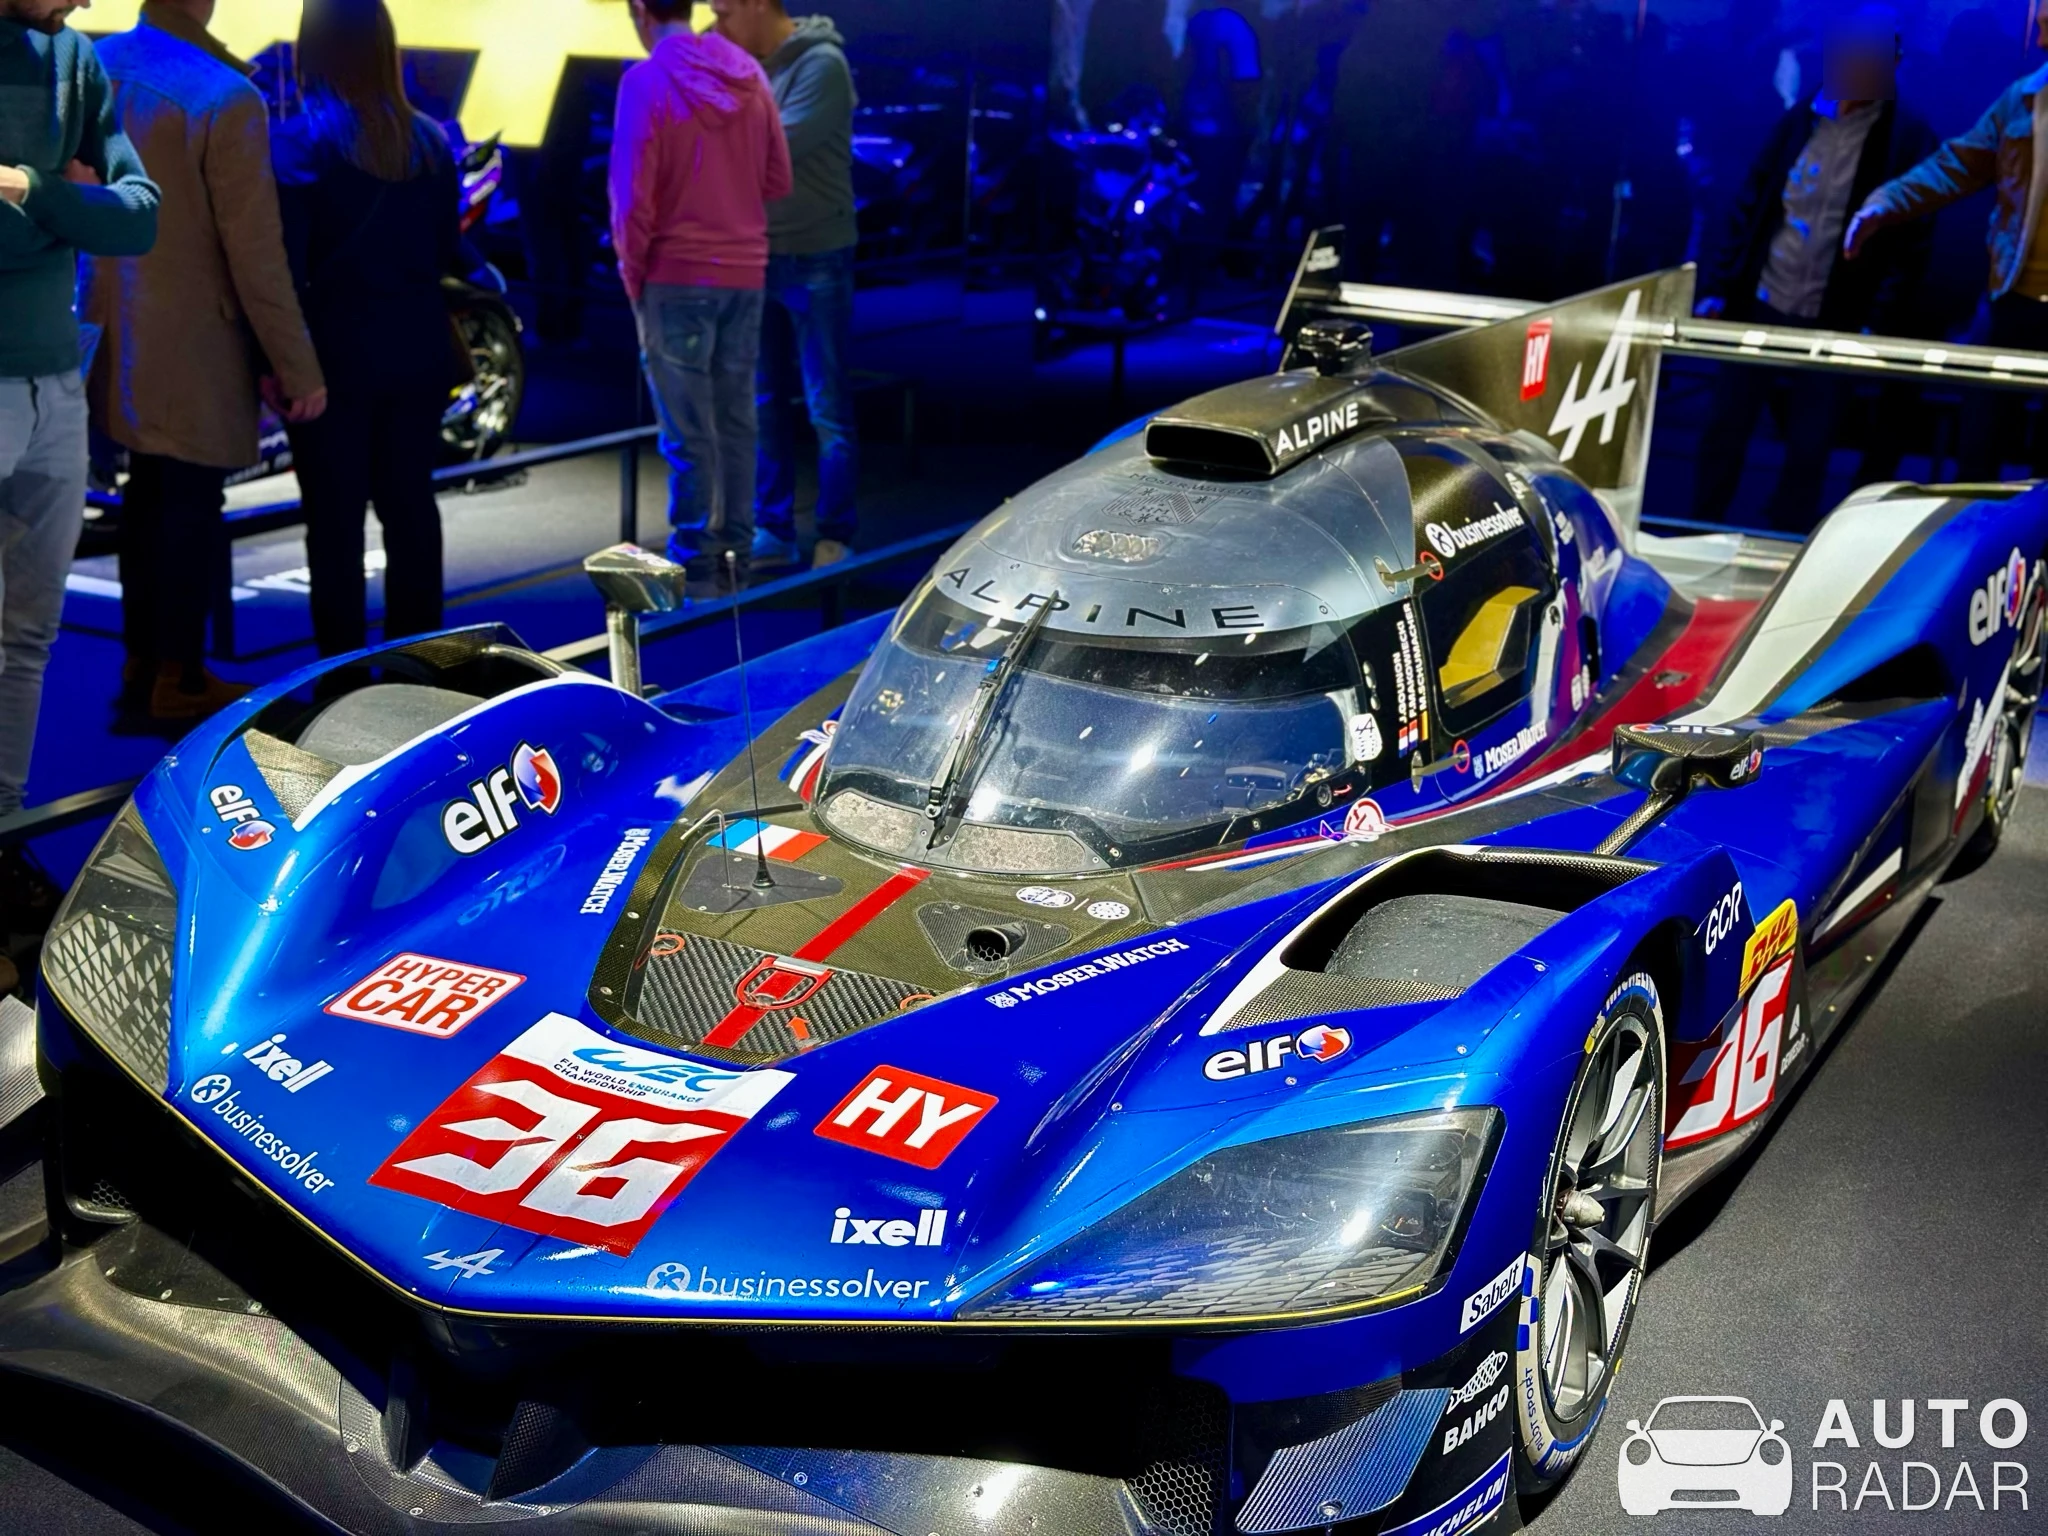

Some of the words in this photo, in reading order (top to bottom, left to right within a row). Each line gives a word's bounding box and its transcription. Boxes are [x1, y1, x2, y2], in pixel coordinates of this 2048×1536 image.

[1523, 333, 1550, 387] HY
[1275, 402, 1358, 456] ALPINE
[1442, 502, 1524, 549] businessolver
[943, 567, 1264, 630] ALPINE
[1969, 566, 2007, 646] elf
[1397, 620, 1417, 718] F.MAKOWIECKI
[1403, 603, 1427, 710] M.SCHUMACHER
[1393, 652, 1407, 723] J.GOUNON
[1730, 756, 1749, 780] elf
[210, 785, 260, 823] elf
[444, 768, 518, 853] elf
[1008, 938, 1189, 1002] MOSER.WATCH
[1750, 907, 1793, 979] DHL
[347, 980, 478, 1030] CAR
[384, 960, 507, 998] HYPER
[242, 1034, 334, 1093] ixell
[554, 1063, 646, 1097] CHAMPIONSHIP
[560, 1058, 579, 1072] FIA
[584, 1069, 627, 1085] WORLD
[628, 1081, 703, 1103] ENDURANCE
[1205, 1035, 1291, 1080] elf
[212, 1091, 335, 1194] businessolver
[833, 1077, 984, 1149] HY
[392, 1080, 727, 1227] 36
[830, 1207, 948, 1247] ixell
[699, 1267, 929, 1299] businessolver
[1469, 1264, 1519, 1323] Sabelt
[1443, 1384, 1509, 1455] BAHCO
[1525, 1367, 1536, 1418] SPORT
[1530, 1422, 1544, 1451] PILOT
[1422, 1473, 1506, 1536] ICHELIN
